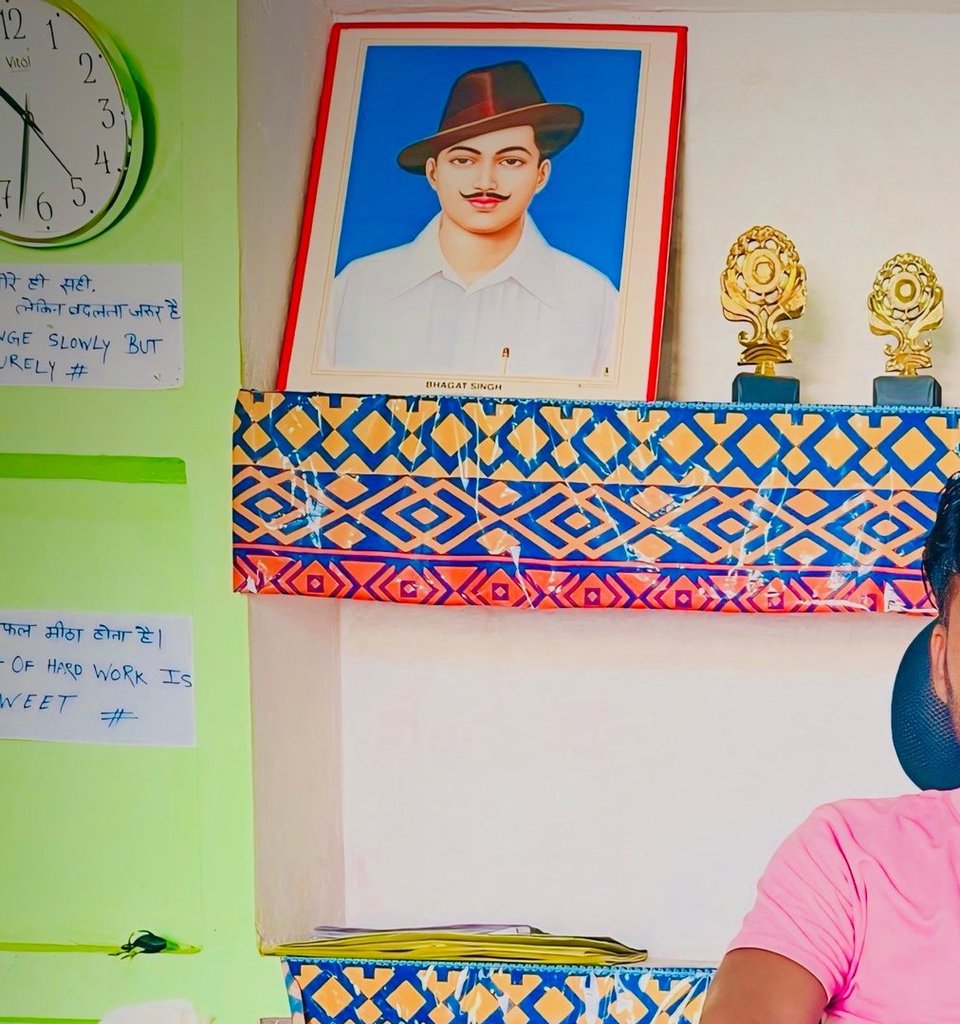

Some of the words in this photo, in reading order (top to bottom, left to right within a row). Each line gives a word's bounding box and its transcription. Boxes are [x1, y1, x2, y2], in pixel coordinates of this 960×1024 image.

[0, 8, 26, 39] 12
[46, 19, 58, 50] 1
[79, 52, 97, 84] 2
[98, 98, 115, 129] 3
[94, 145, 111, 174] 4
[0, 180, 11, 209] 7
[36, 192, 53, 222] 6
[70, 177, 87, 207] 5
[49, 333, 111, 363] SLOWLY
[124, 333, 163, 355] BUT
[426, 381, 467, 389] BHAGAT
[12, 655, 35, 673] OF
[48, 658, 83, 681] HARD
[93, 663, 148, 688] WORK
[160, 668, 192, 688] IS
